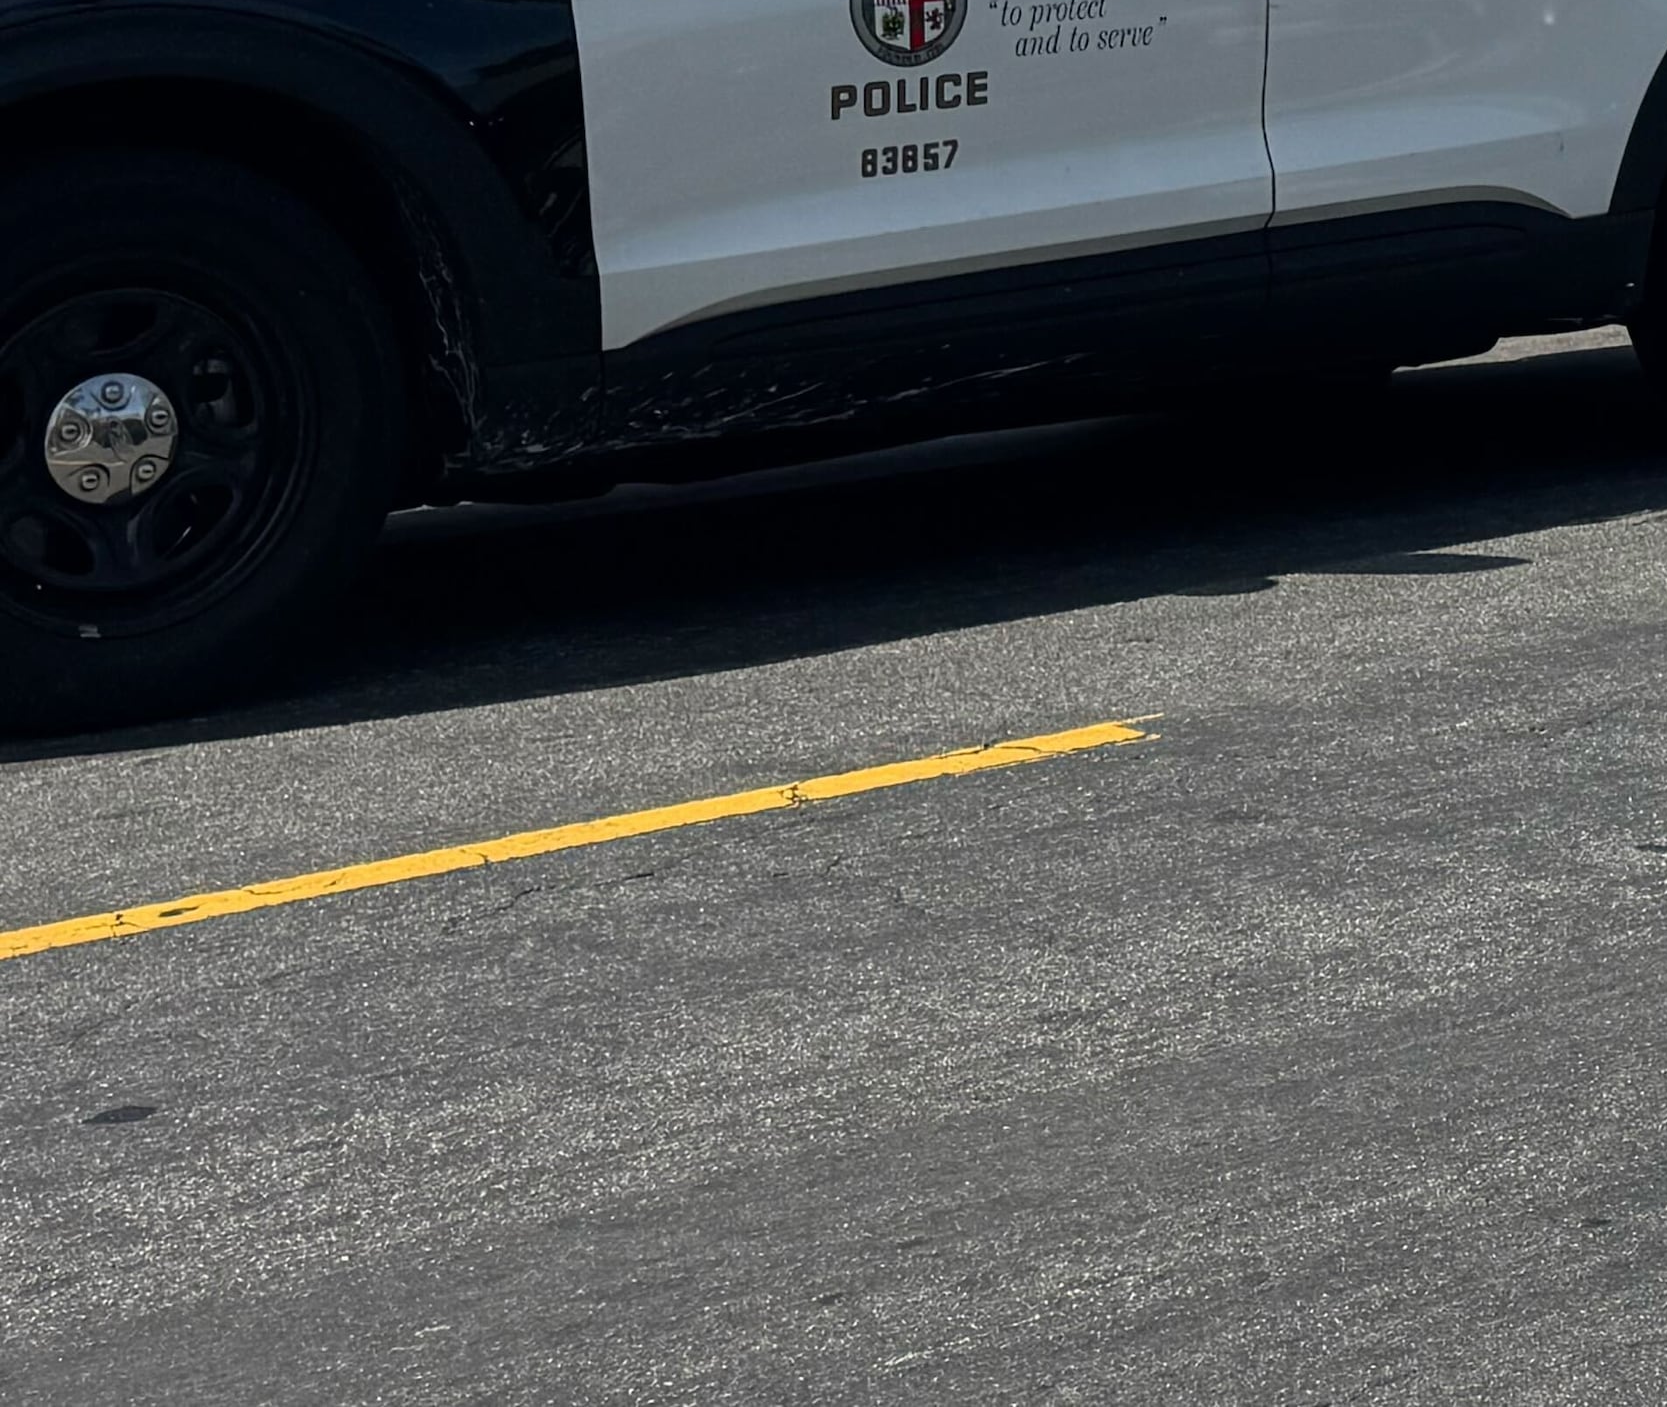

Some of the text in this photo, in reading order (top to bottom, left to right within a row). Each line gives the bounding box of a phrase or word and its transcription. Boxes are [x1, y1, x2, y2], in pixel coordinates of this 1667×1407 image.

[1015, 24, 1062, 57] and
[1069, 26, 1090, 52] to
[830, 70, 989, 121] POLICE
[861, 139, 959, 179] 83857
